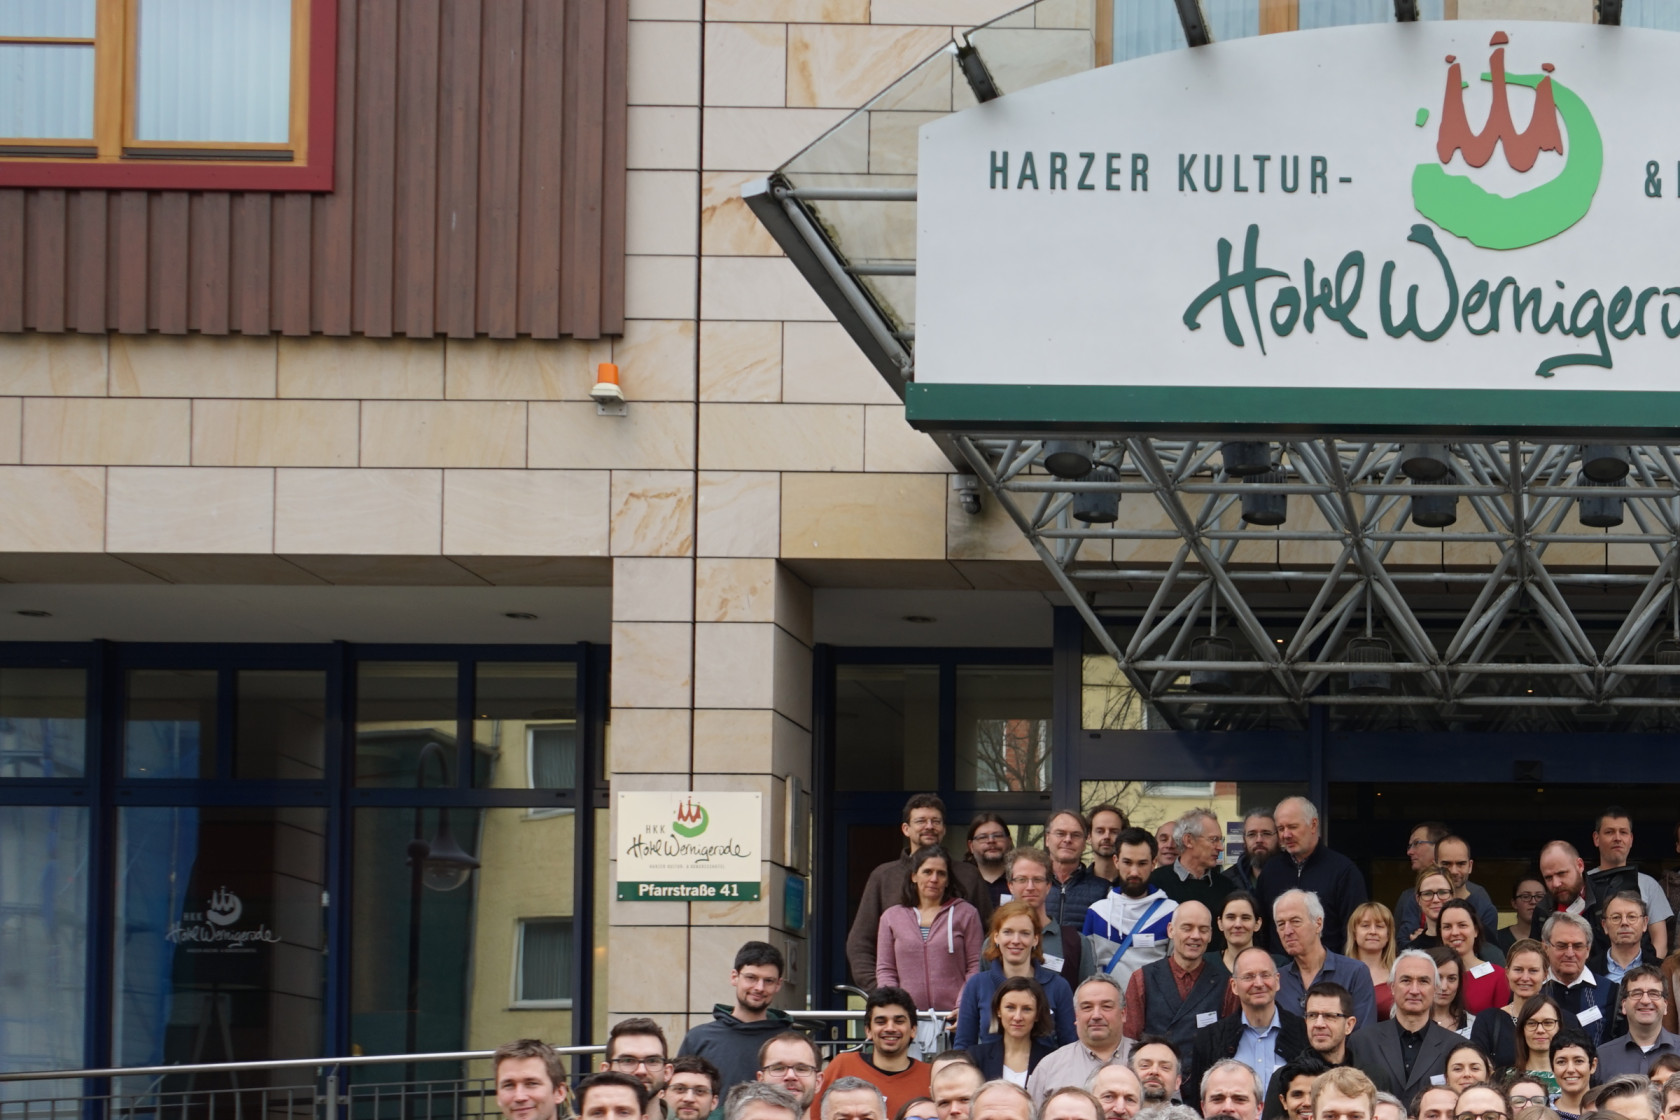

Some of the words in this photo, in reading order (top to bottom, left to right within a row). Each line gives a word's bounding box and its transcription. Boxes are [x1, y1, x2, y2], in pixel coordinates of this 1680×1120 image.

[989, 150, 1149, 192] HARZER
[1178, 153, 1352, 195] KULTUR-
[1183, 223, 1368, 356] Hotel
[645, 824, 667, 834] HKK
[626, 834, 663, 860] Hotel
[664, 834, 752, 863] Wernigerode
[639, 883, 717, 897] Pfarrstraße
[720, 883, 739, 897] 41
[165, 921, 200, 944] Hotel
[200, 921, 282, 948] Wernigerode
